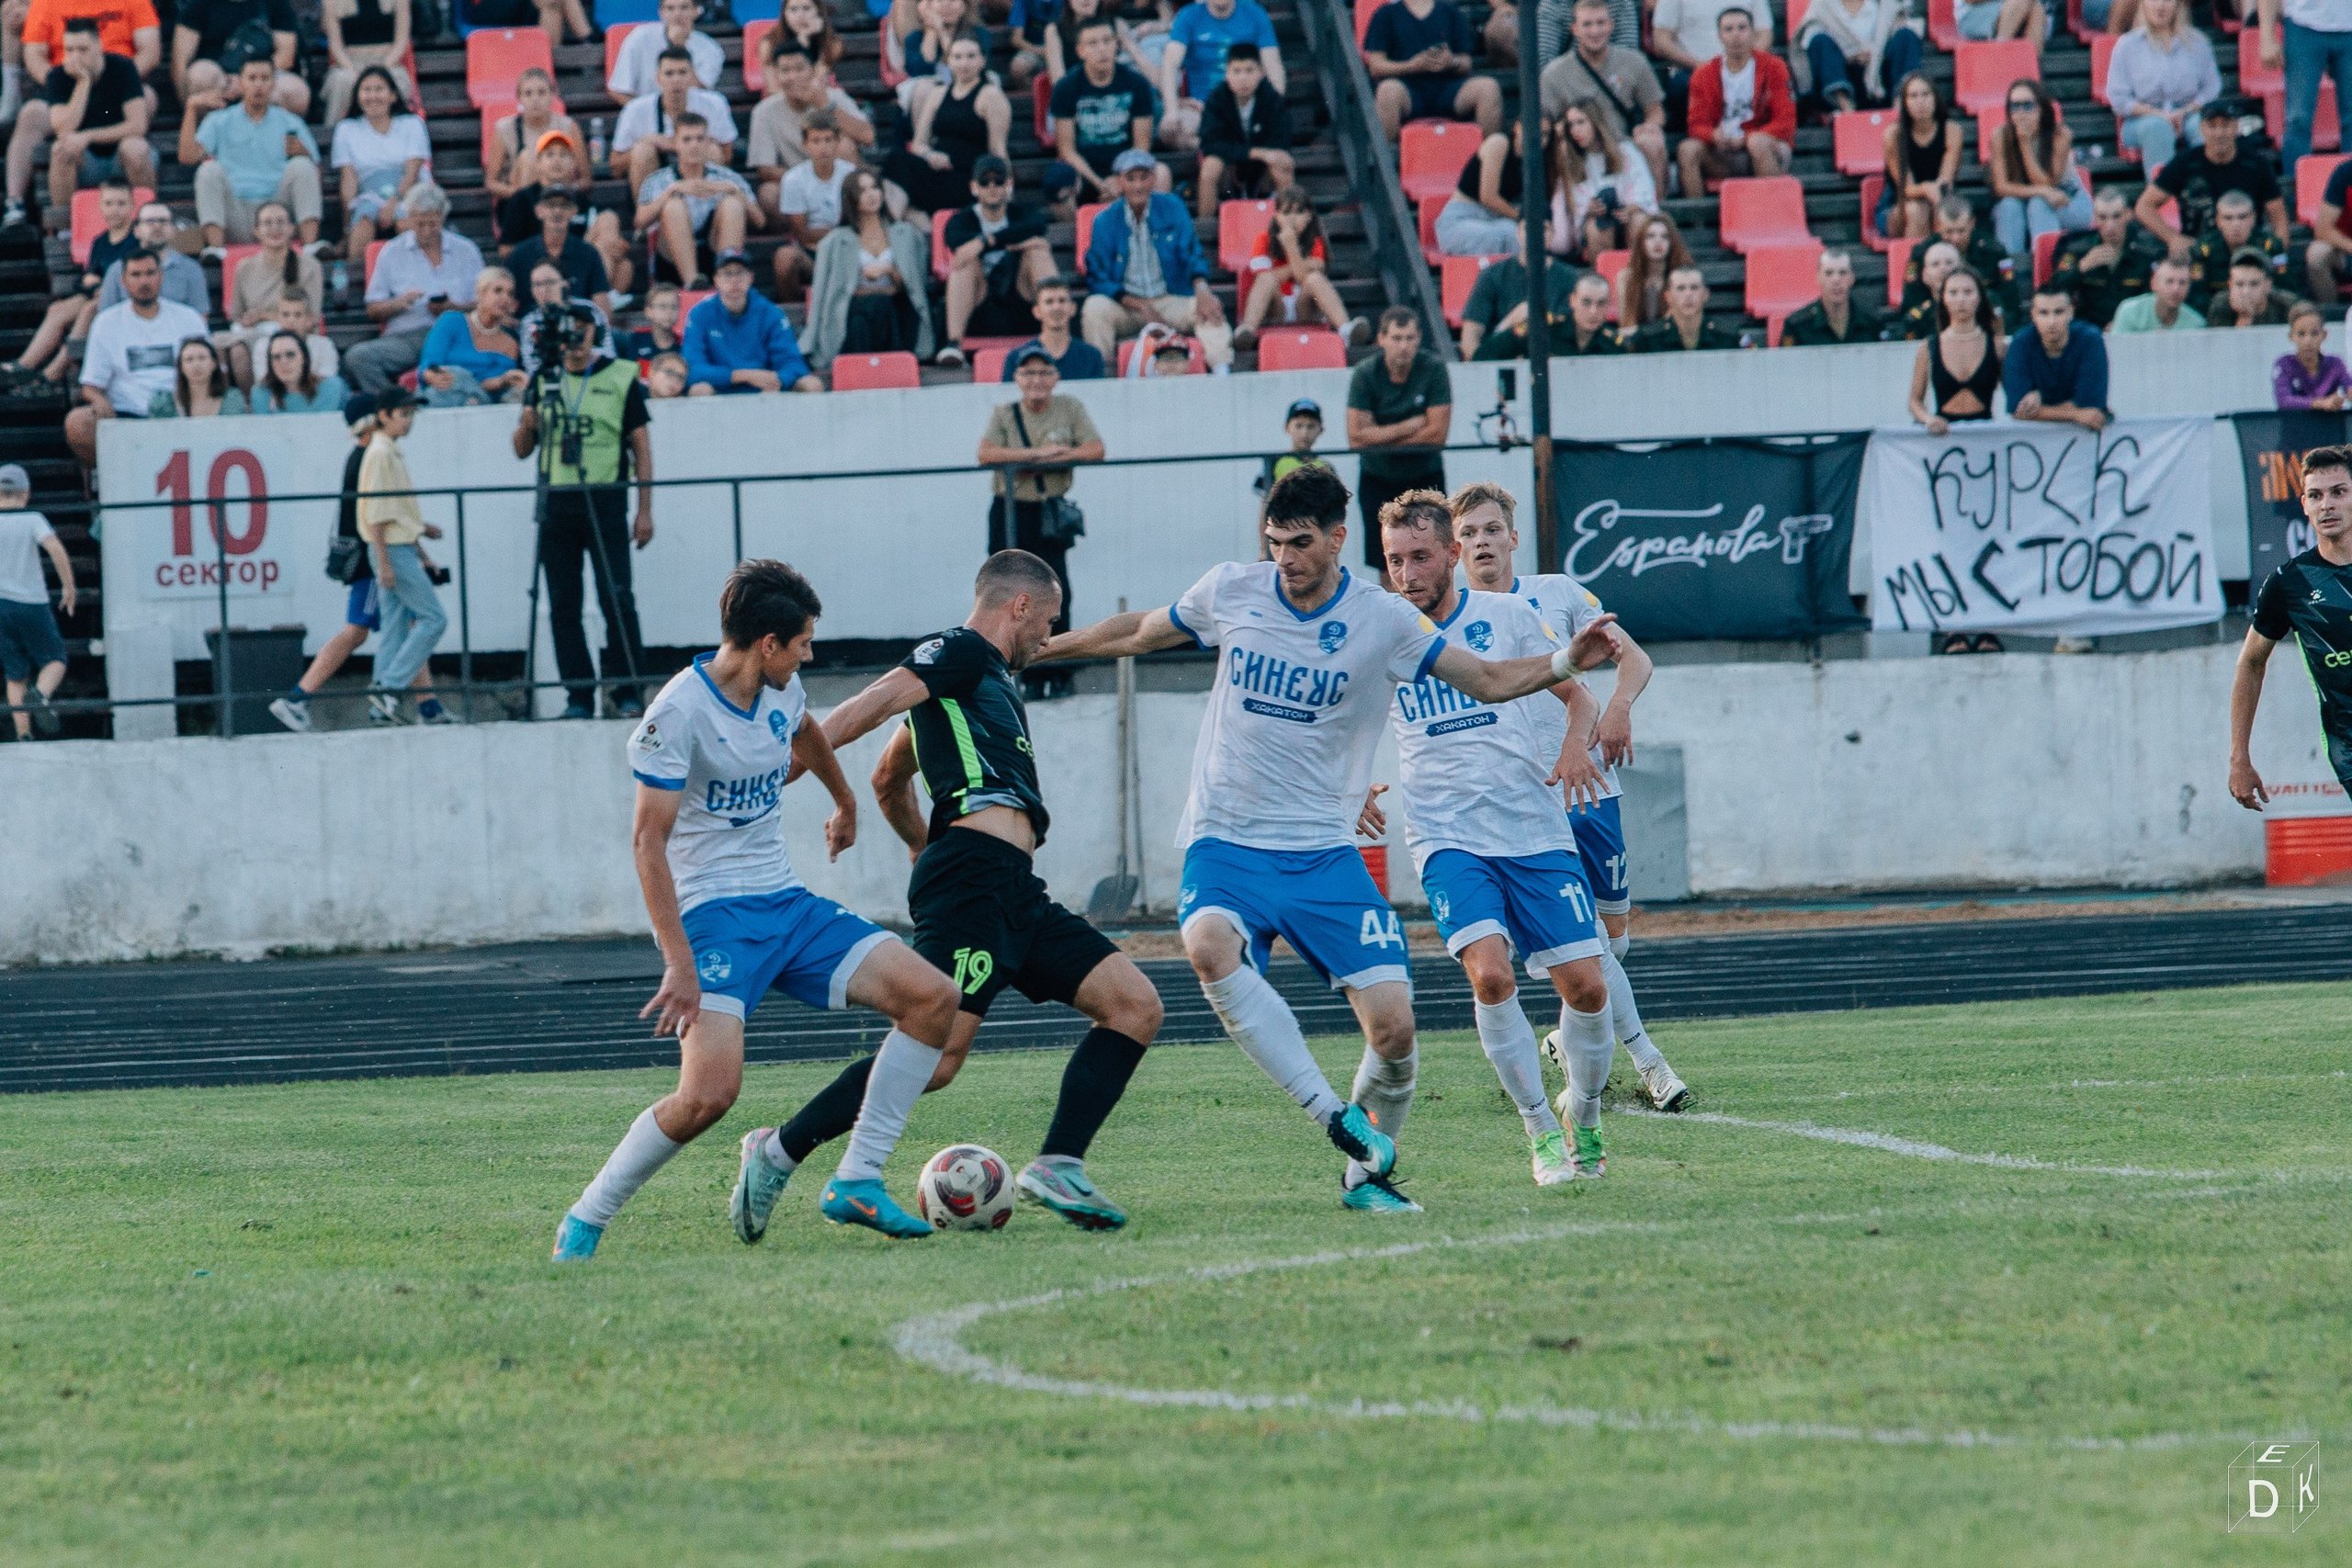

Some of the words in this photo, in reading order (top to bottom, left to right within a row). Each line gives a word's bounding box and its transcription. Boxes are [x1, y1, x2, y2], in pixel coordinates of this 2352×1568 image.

[156, 447, 268, 556] 10
[1923, 434, 2151, 531] КУРСК
[155, 558, 279, 591] сектор
[1885, 553, 1968, 631] МЫ
[1972, 538, 2019, 611] С
[2018, 531, 2202, 604] ТОБОЙ
[1250, 701, 1309, 720] ХАКАТОН
[1435, 715, 1490, 733] ХАКАТОН
[1558, 882, 1593, 923] 11
[1360, 908, 1405, 951] 44
[953, 947, 993, 995] 19
